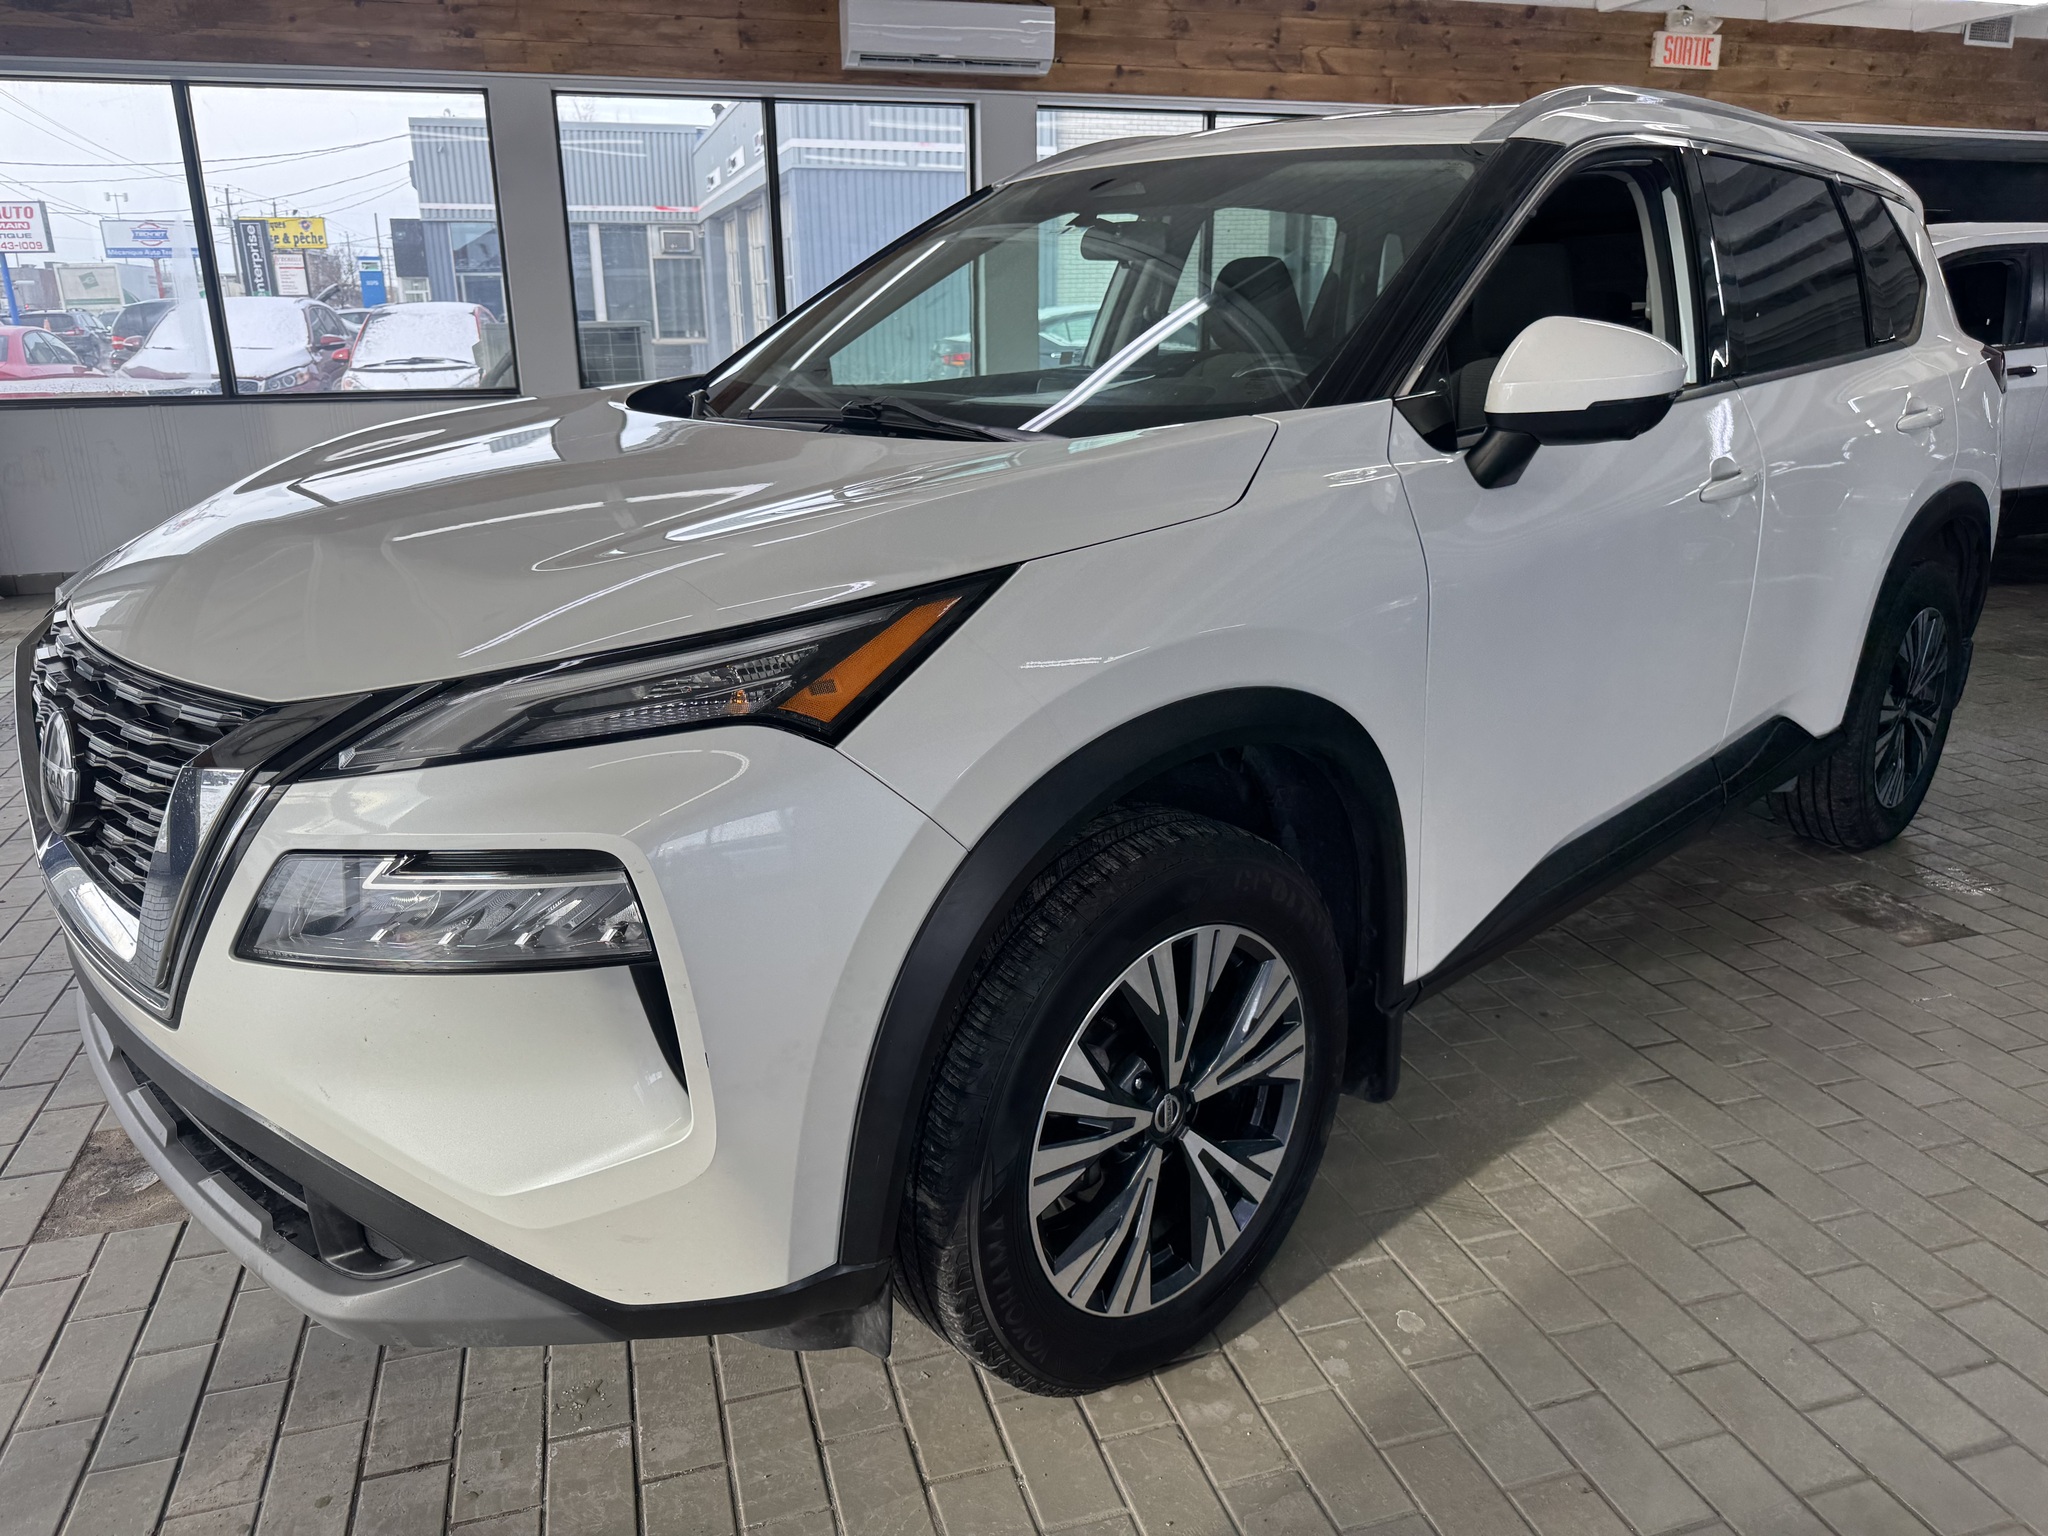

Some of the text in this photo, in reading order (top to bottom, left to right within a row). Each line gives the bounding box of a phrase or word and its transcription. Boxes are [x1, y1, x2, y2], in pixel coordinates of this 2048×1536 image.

[1663, 35, 1715, 66] SORTIE
[0, 206, 34, 219] UTO
[283, 233, 291, 244] &
[293, 231, 324, 247] pêche
